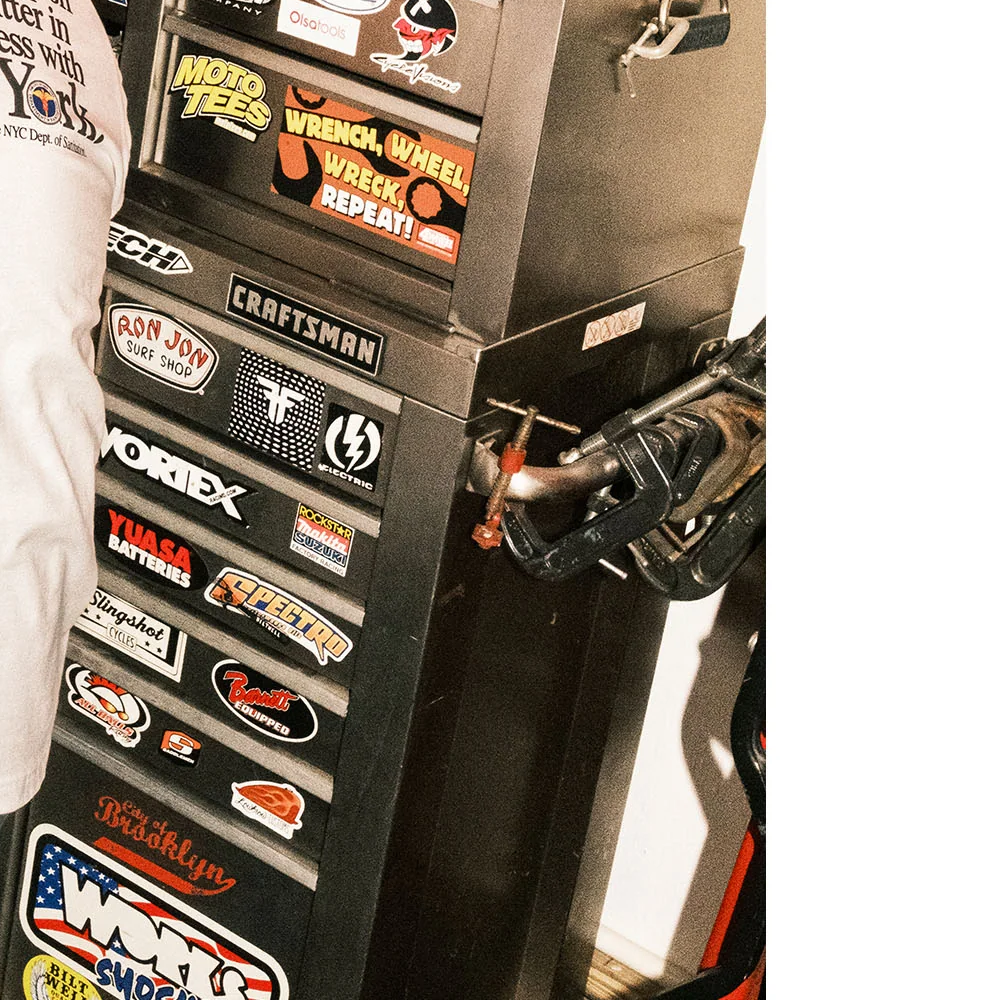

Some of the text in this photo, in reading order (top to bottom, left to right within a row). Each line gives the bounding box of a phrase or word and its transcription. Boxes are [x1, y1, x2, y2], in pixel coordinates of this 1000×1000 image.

[49, 6, 72, 46] in
[38, 41, 86, 87] with
[174, 56, 264, 100] MOTO
[182, 84, 271, 128] TEES
[3, 123, 28, 140] NYC
[29, 127, 53, 147] Dept.
[54, 134, 63, 147] of
[285, 107, 383, 157] WRENCH,
[391, 132, 470, 197] WHEEL,
[324, 150, 405, 213] WRECK,
[320, 183, 415, 241] REPEAT!
[117, 313, 208, 371] RON JON
[233, 284, 377, 366] CRAFTSMAN
[126, 340, 193, 379] SURF SHOP
[100, 426, 247, 521] VORTEX
[318, 463, 374, 491] ELECTRIC
[107, 508, 192, 575] YUASA
[107, 533, 192, 589] BATTERIES
[291, 543, 344, 575] FACTORY RACING
[293, 531, 348, 567] SUZUKI
[88, 590, 164, 642] Slingshot
[108, 627, 135, 649] CYCLES
[209, 572, 349, 661] SPECTRO
[74, 697, 135, 737] ALL BALLS
[233, 700, 291, 736] EQUIPPED
[94, 796, 228, 885] Brooklyn
[152, 820, 168, 836] of
[49, 962, 89, 995] BILT
